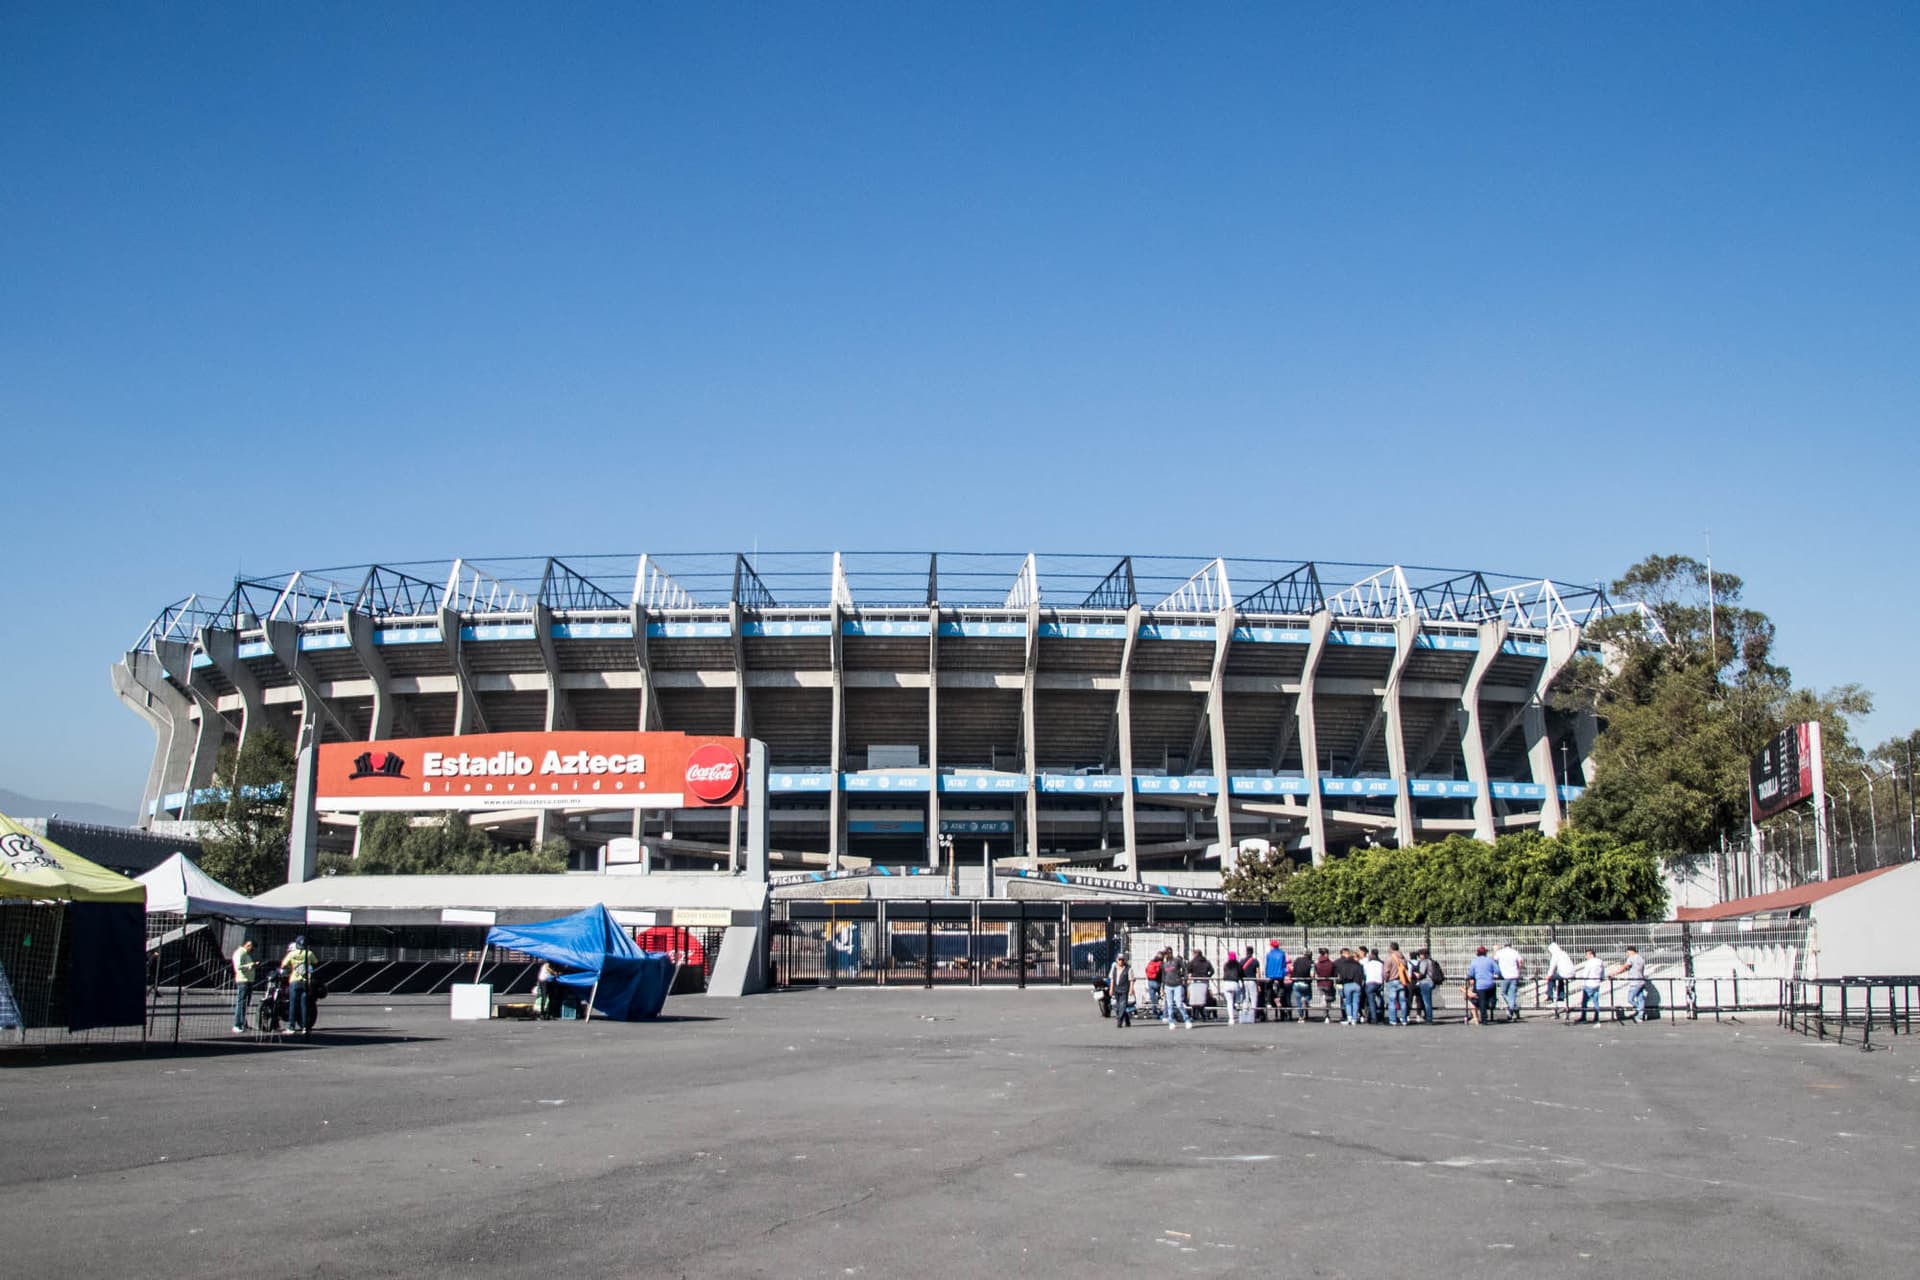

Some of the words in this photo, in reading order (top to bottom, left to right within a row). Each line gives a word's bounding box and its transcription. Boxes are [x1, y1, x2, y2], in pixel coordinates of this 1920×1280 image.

[423, 752, 533, 776] Estadio
[540, 750, 645, 774] Azteca
[686, 762, 736, 782] Coca-Cola
[423, 780, 645, 792] Bienvenidos
[1075, 876, 1150, 892] BIENVENIDOS
[1176, 888, 1198, 897] AT&T
